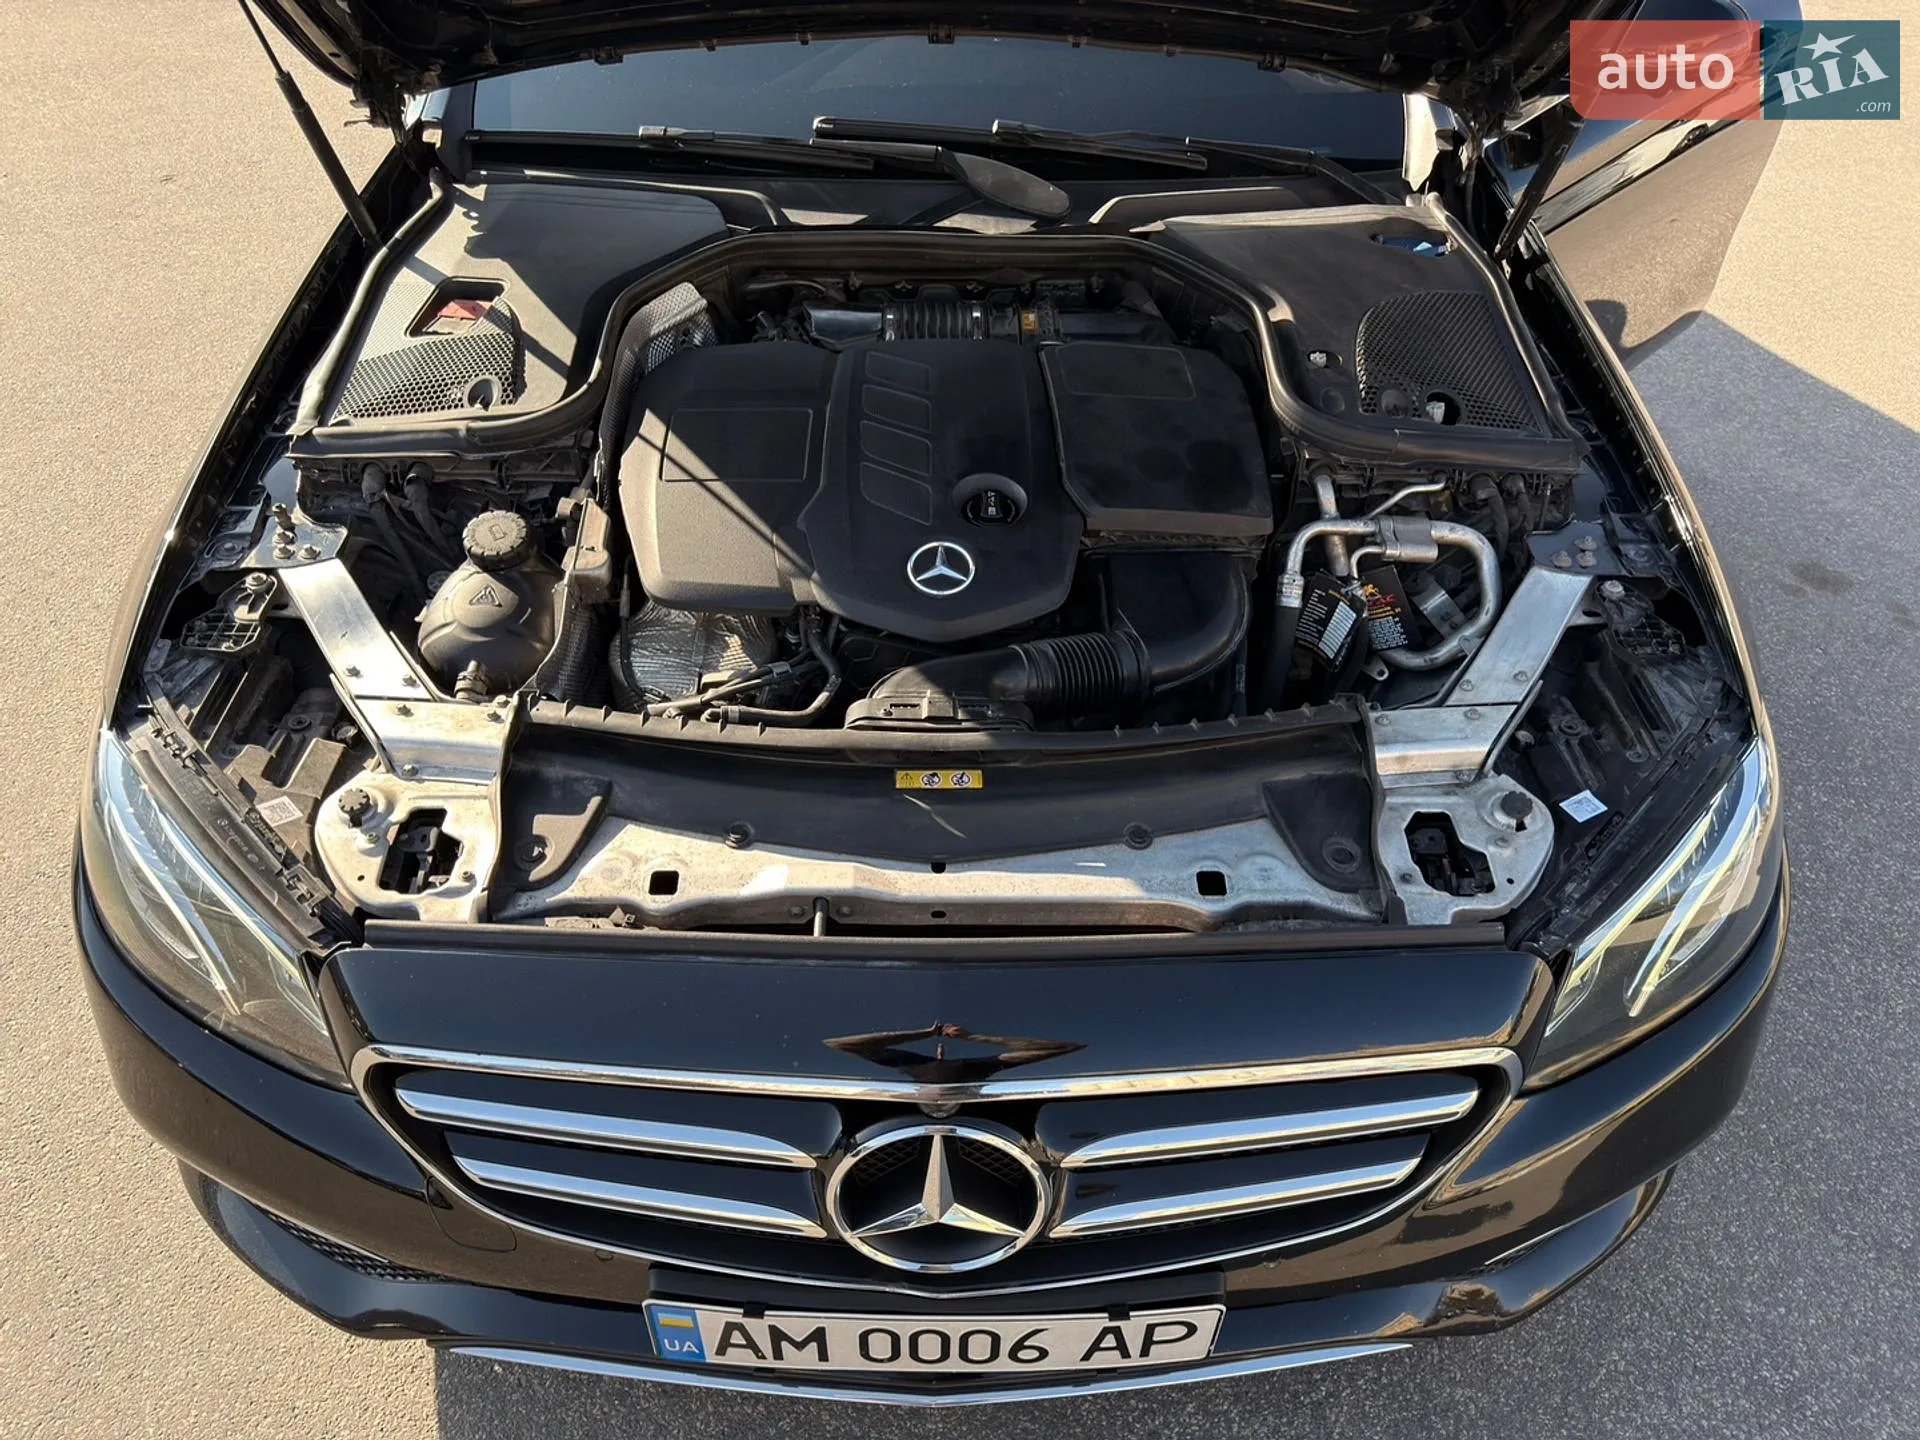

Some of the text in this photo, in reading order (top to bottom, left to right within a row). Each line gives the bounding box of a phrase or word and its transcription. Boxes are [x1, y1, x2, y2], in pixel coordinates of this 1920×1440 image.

[664, 1338, 700, 1354] UA
[715, 1320, 1198, 1364] AM 0006 AP
